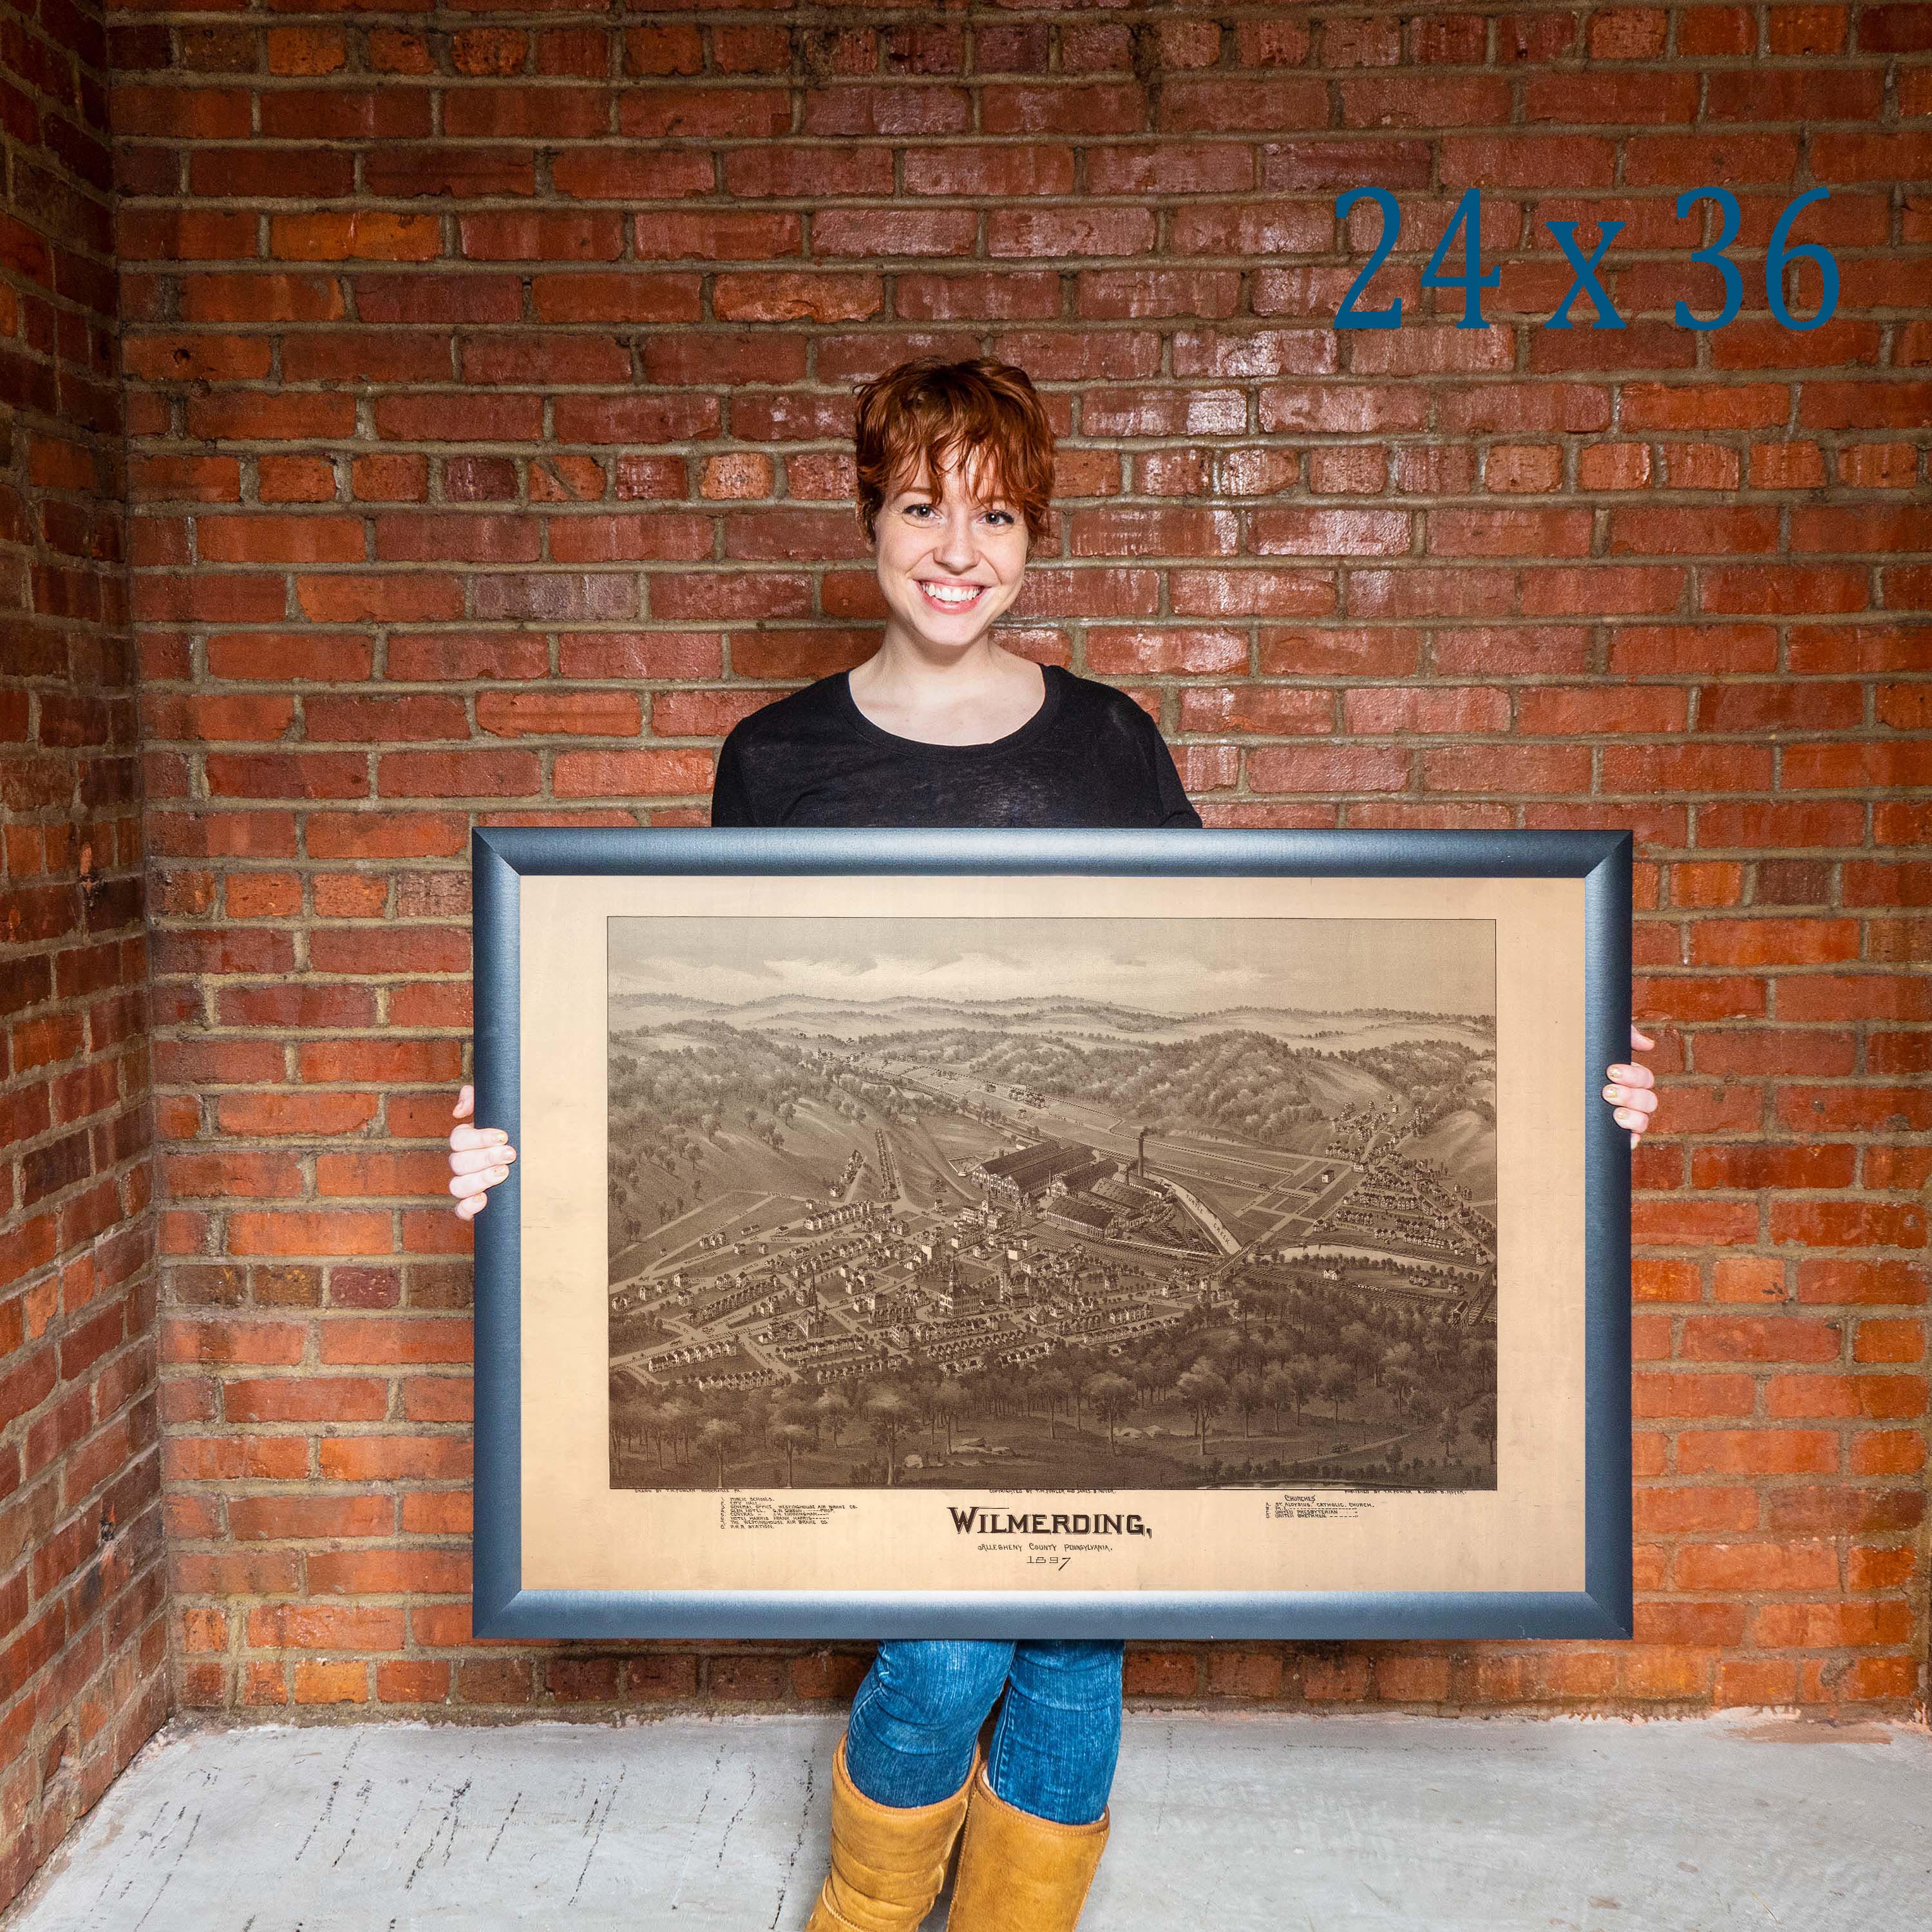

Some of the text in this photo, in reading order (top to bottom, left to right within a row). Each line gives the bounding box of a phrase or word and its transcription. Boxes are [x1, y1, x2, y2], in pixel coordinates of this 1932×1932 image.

[1186, 1194, 1230, 1245] TURTLE CREEK
[1284, 1494, 1316, 1504] CHURCHES
[946, 1506, 1152, 1540] WILMERDING,
[978, 1542, 1113, 1552] ALLEGHENY COUNTY PENNSYLVANIA.
[1026, 1555, 1071, 1571] 1897
